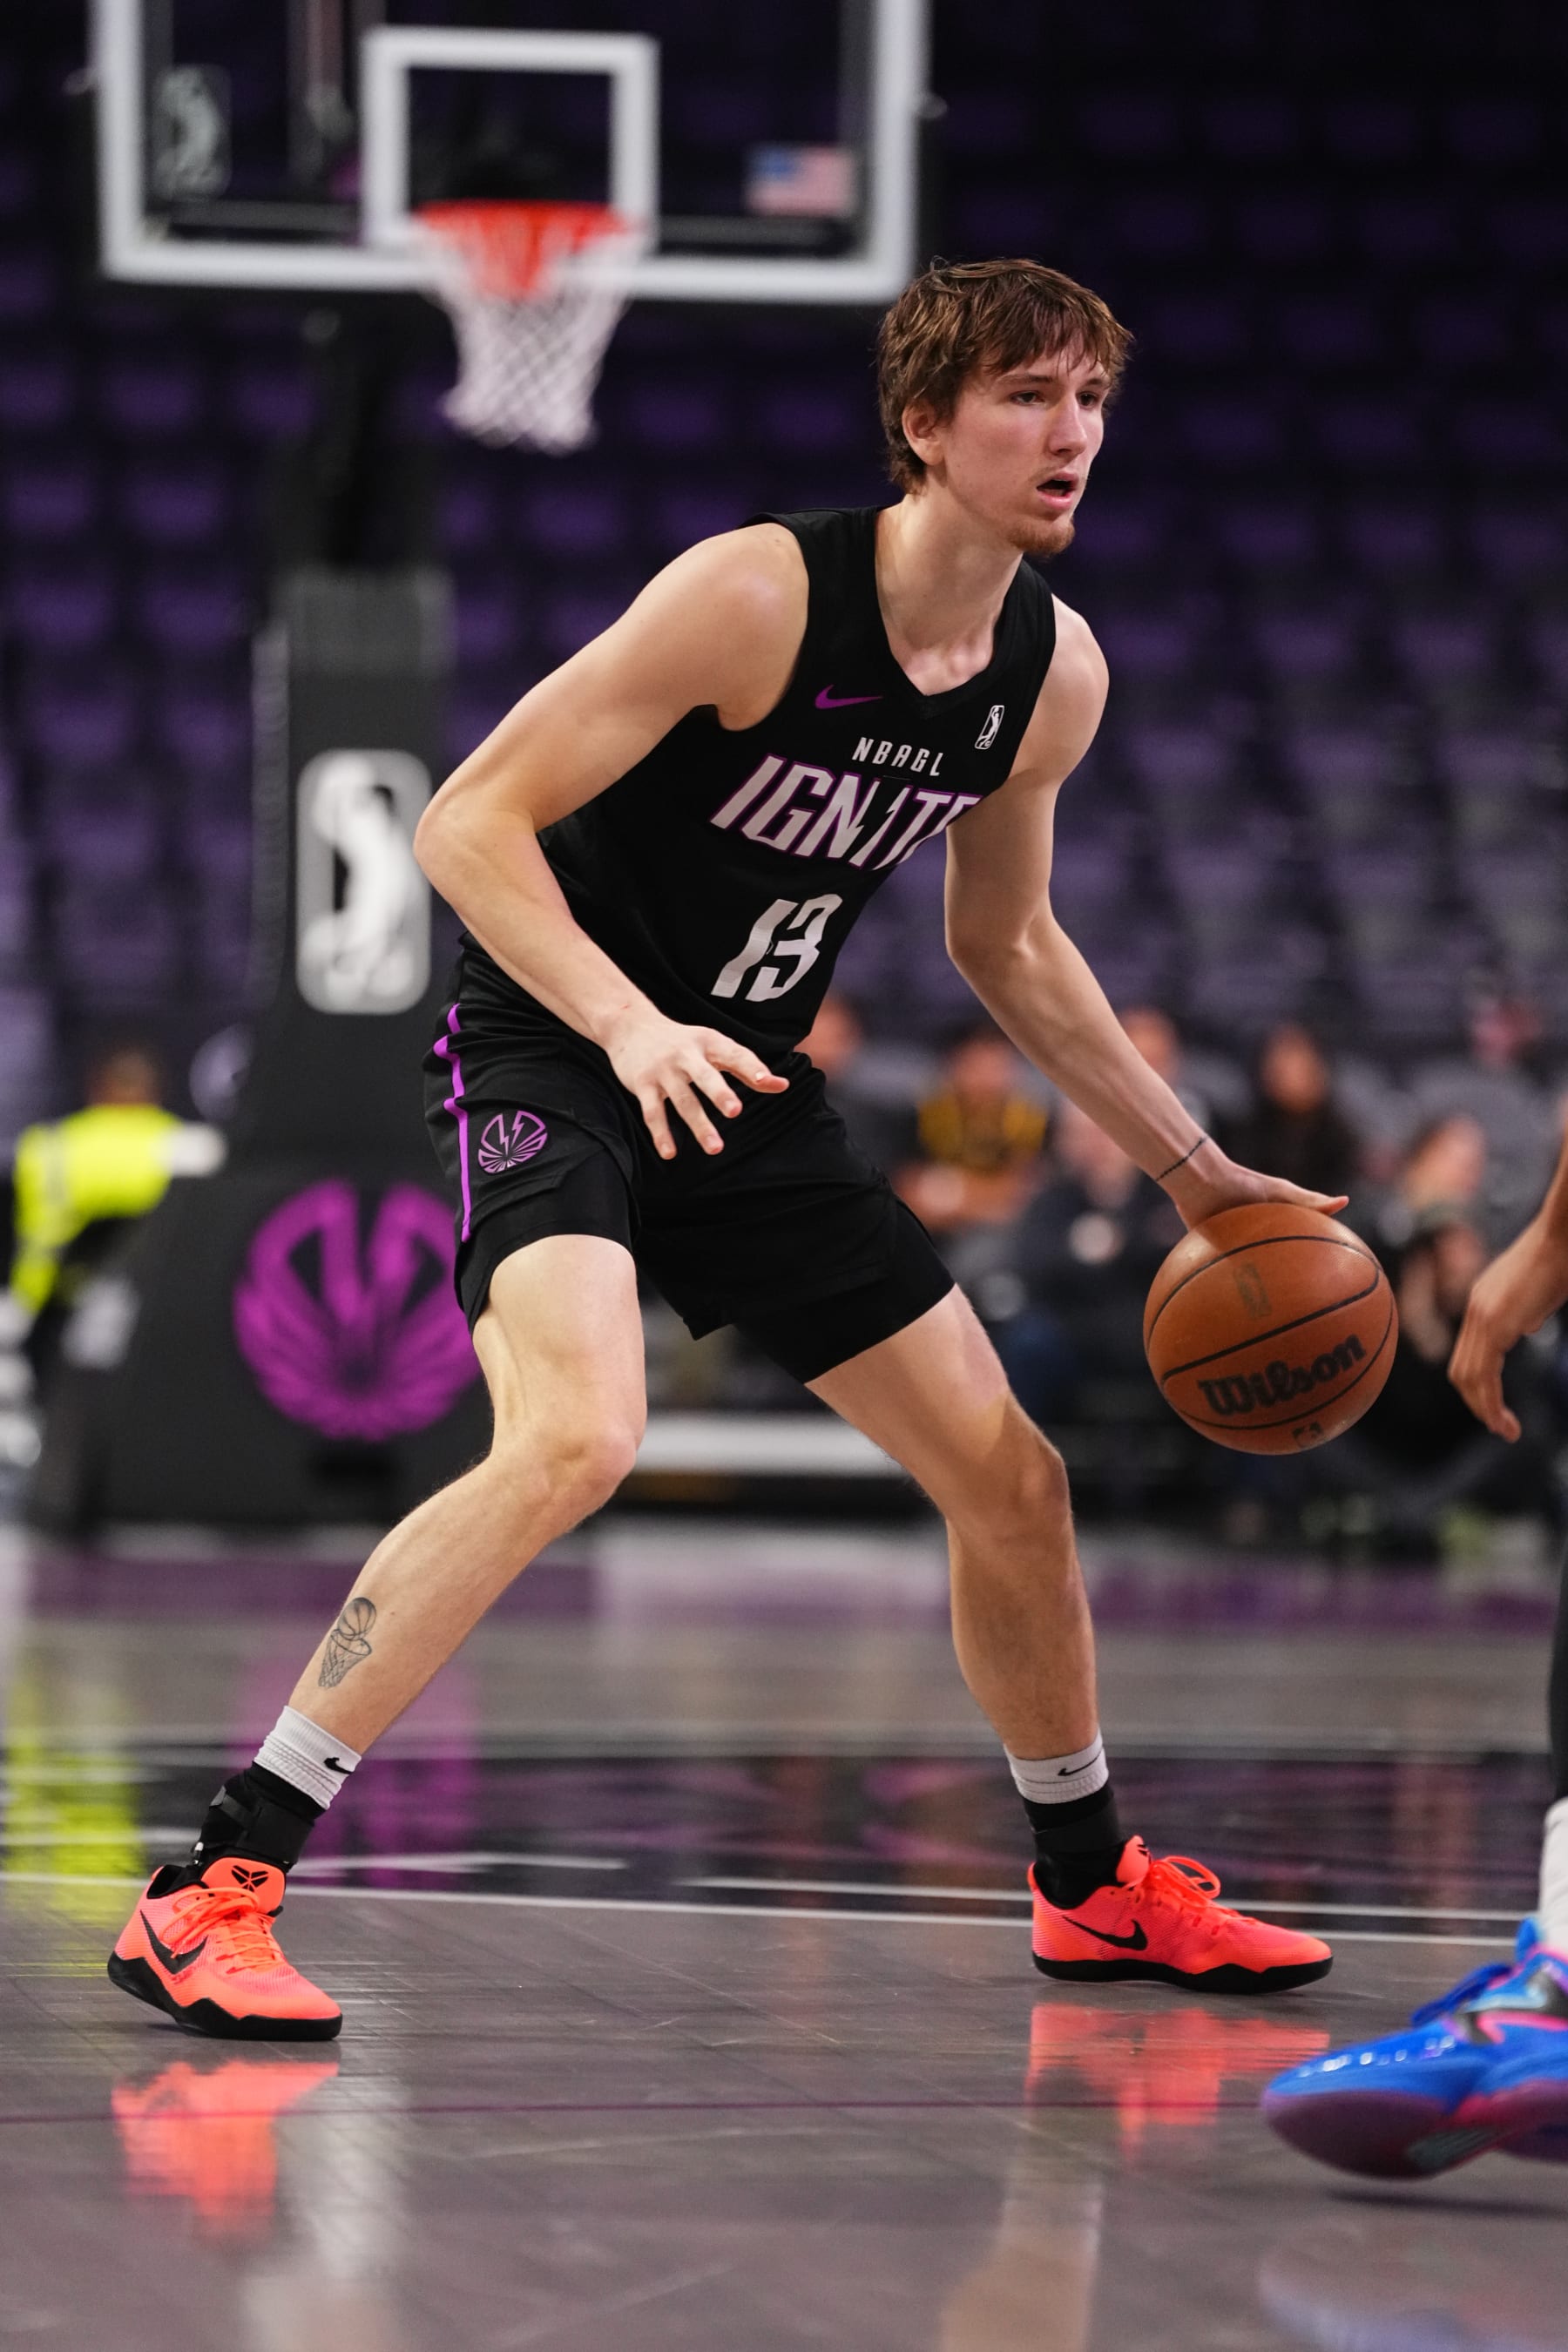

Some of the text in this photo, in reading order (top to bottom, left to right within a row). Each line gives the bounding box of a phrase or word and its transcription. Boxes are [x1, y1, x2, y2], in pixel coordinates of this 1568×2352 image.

[852, 737, 943, 776] NBAGL
[710, 894, 843, 1002] 13
[1197, 1334, 1367, 1416] Wilson
